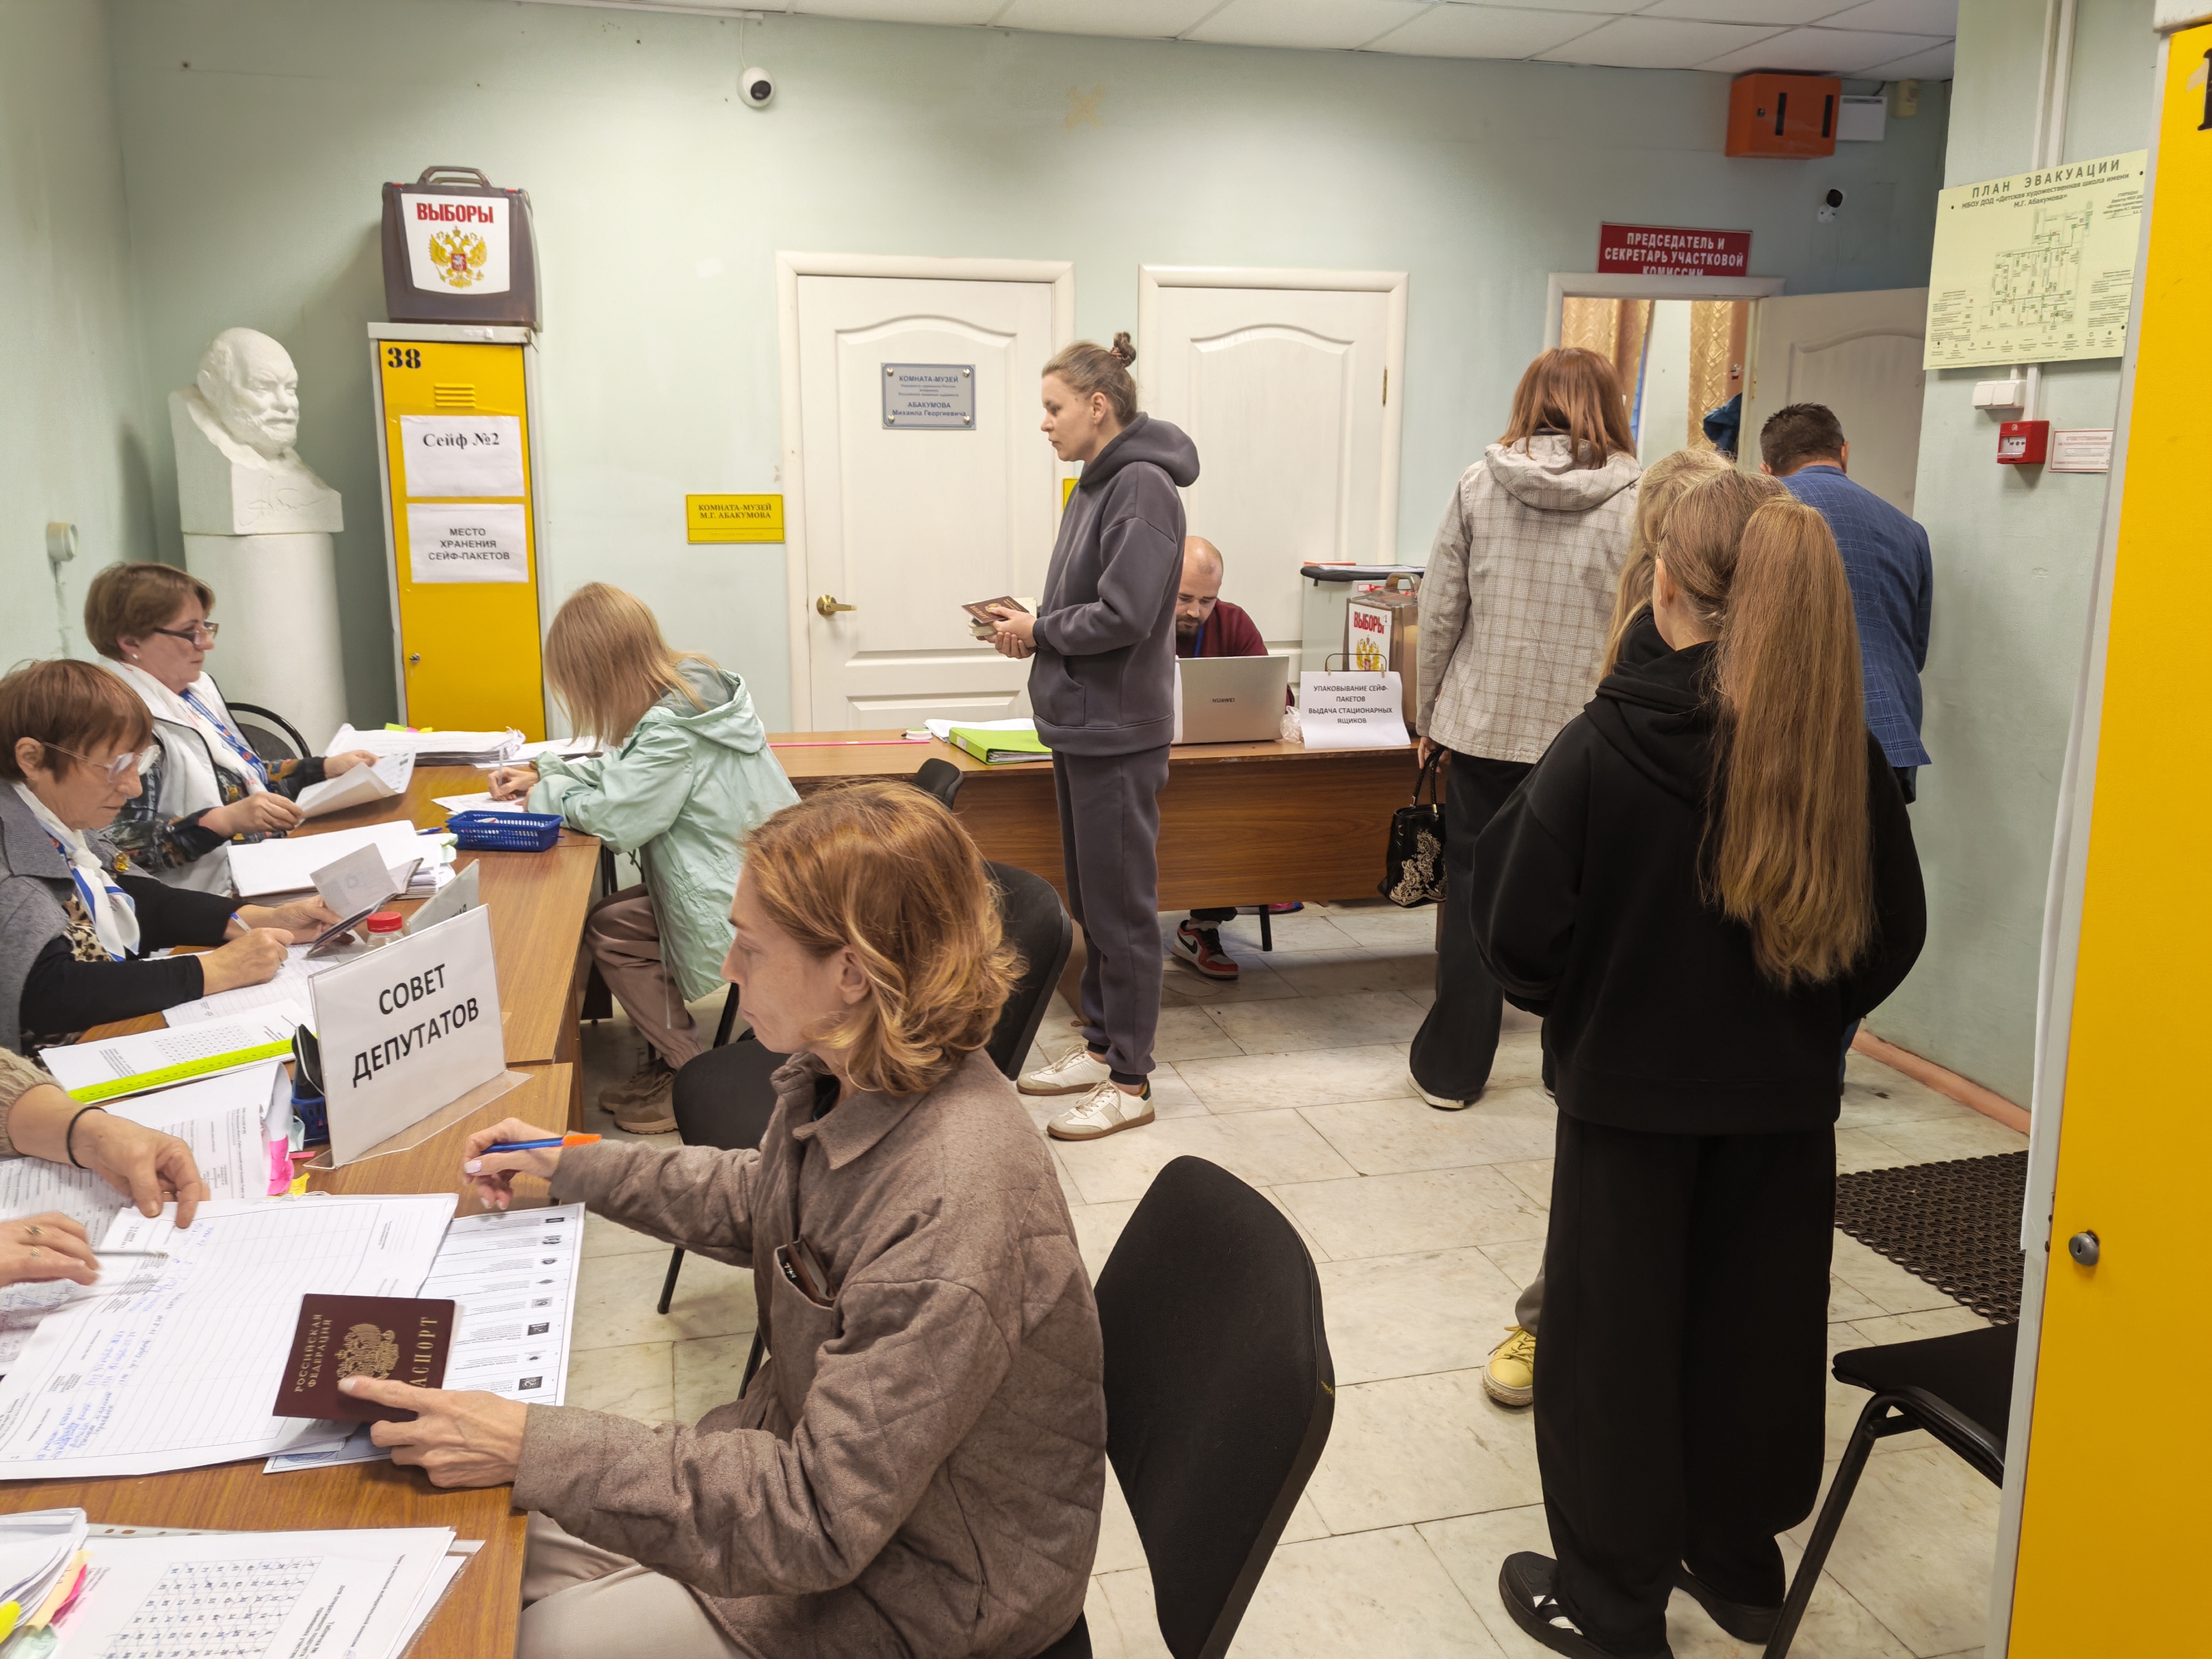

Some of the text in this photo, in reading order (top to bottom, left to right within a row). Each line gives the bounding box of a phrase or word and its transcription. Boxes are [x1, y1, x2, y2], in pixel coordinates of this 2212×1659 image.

[1972, 159, 2120, 198] ПЛАН ЭВАКУАЦИИ
[1980, 198, 1994, 207] ДОД
[2082, 178, 2105, 186] школа
[2107, 174, 2129, 182] имени
[416, 203, 494, 224] ВЫБОРЫ
[1627, 233, 1725, 249] ПРЕДСЕДАТЕЛЬ И
[1604, 247, 1743, 267] СЕКРЕТАРЬ УЧАСТКОВОЙ
[388, 347, 422, 369] 38
[423, 432, 500, 449] Сейф №2
[449, 528, 486, 536] МЕСТО
[440, 540, 496, 549] ХРАНЕНИЯ
[428, 551, 510, 561] СЕЙФ-ПАКЕТОВ
[1353, 611, 1384, 634] ВЫБОРЫ
[379, 964, 445, 1015] СОВЕТ
[353, 998, 478, 1088] ДЕПУТАТОВ
[294, 1314, 323, 1392] РОССИЙСКАЯ
[308, 1319, 332, 1387] ФЕДЕРАЦИЯ
[409, 1317, 438, 1387] АСПОРТ
